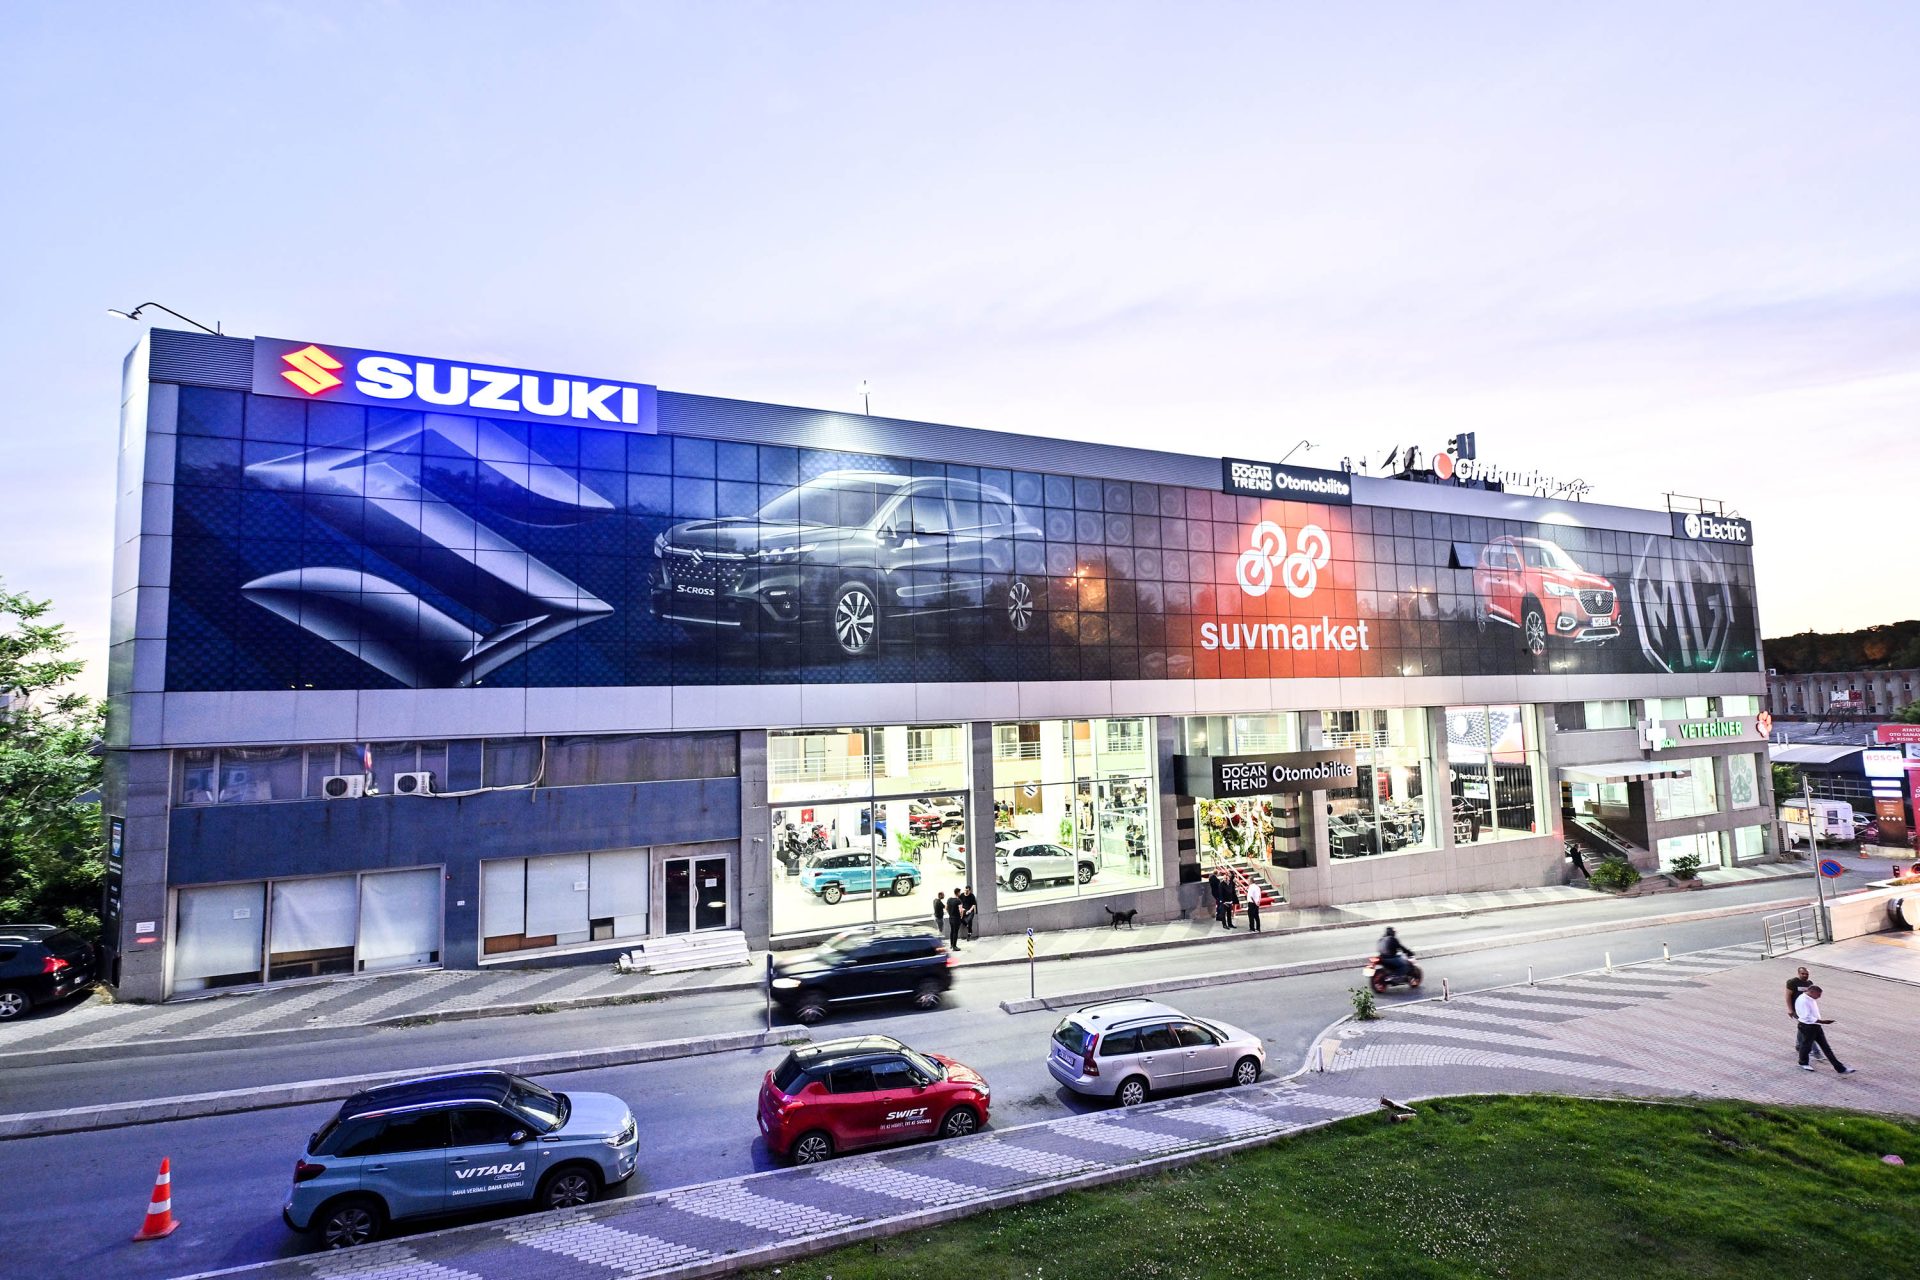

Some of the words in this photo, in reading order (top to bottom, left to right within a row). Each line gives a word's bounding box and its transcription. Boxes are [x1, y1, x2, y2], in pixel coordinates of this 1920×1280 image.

[355, 356, 639, 425] SUZUKI
[1232, 477, 1273, 491] TREND
[1275, 473, 1350, 495] Otomobilite
[1701, 517, 1746, 541] Electric
[1200, 615, 1369, 650] suvmarket
[1680, 718, 1743, 739] VETERİNER
[1272, 761, 1353, 783] Otomobilite
[1222, 777, 1268, 791] TREND
[886, 1107, 928, 1120] SWIFT
[455, 1162, 526, 1178] VITARA
